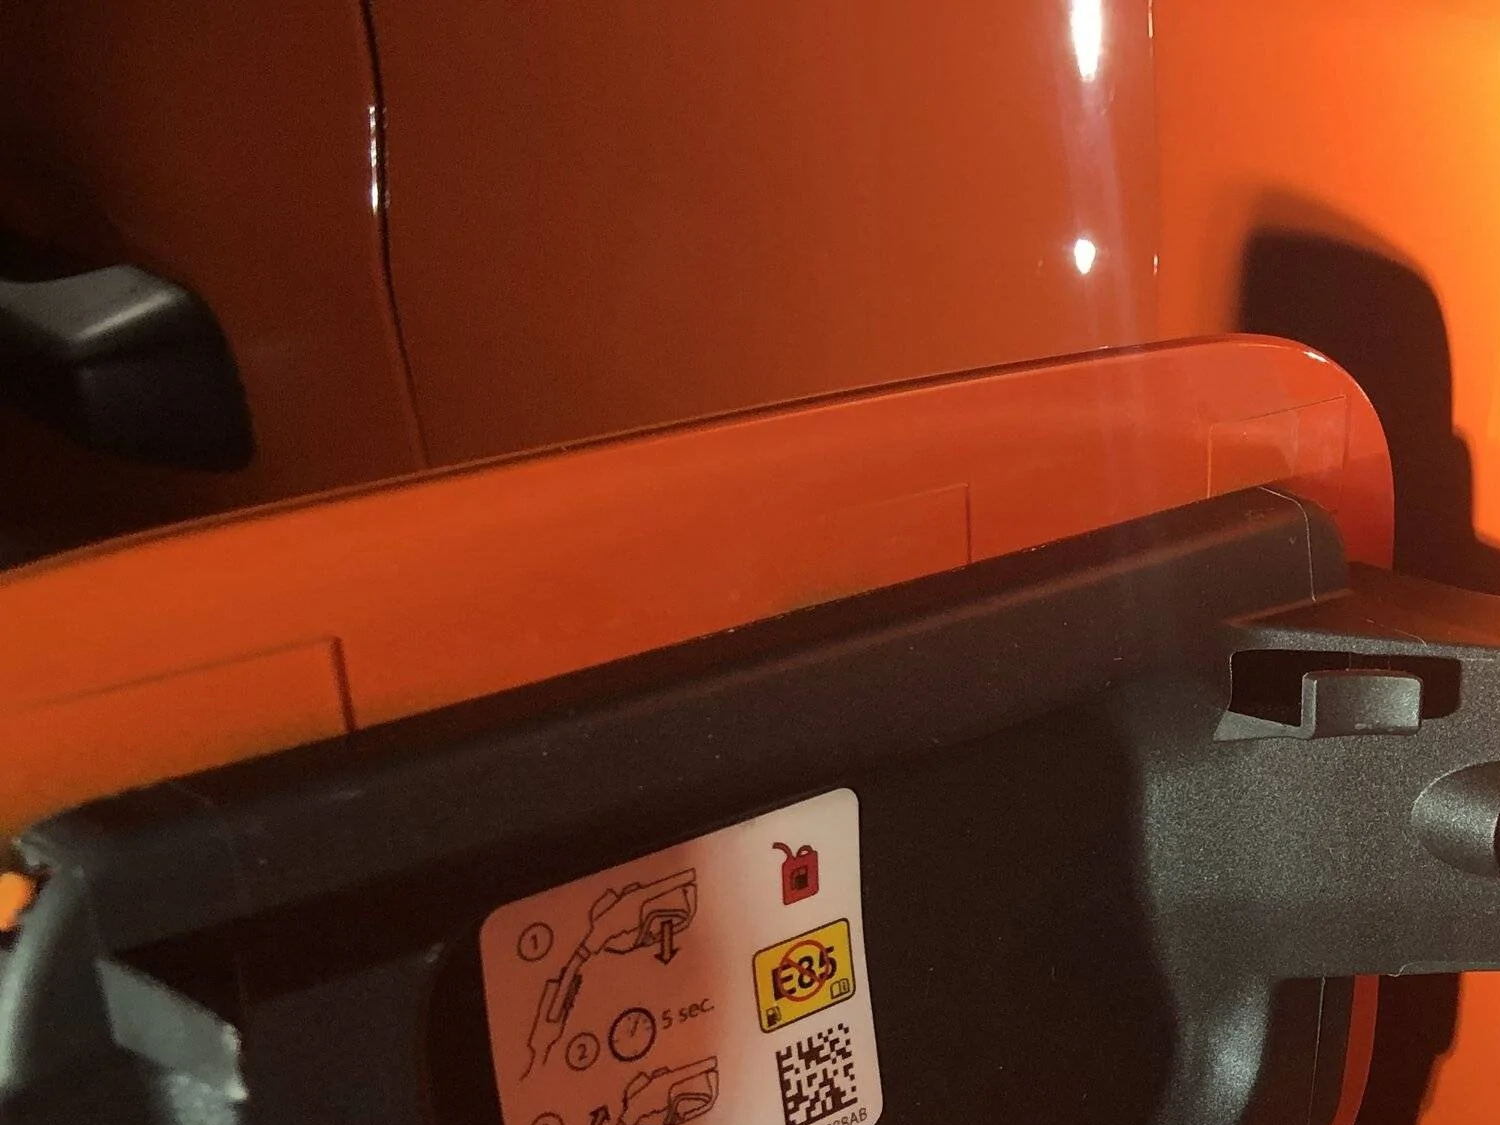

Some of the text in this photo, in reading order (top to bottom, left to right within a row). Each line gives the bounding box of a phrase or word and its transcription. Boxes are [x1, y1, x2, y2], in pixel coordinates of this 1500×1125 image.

[531, 934, 539, 951] 1
[772, 946, 838, 1001] E85
[661, 998, 715, 1030] 5 sec.
[577, 1043, 588, 1061] 2
